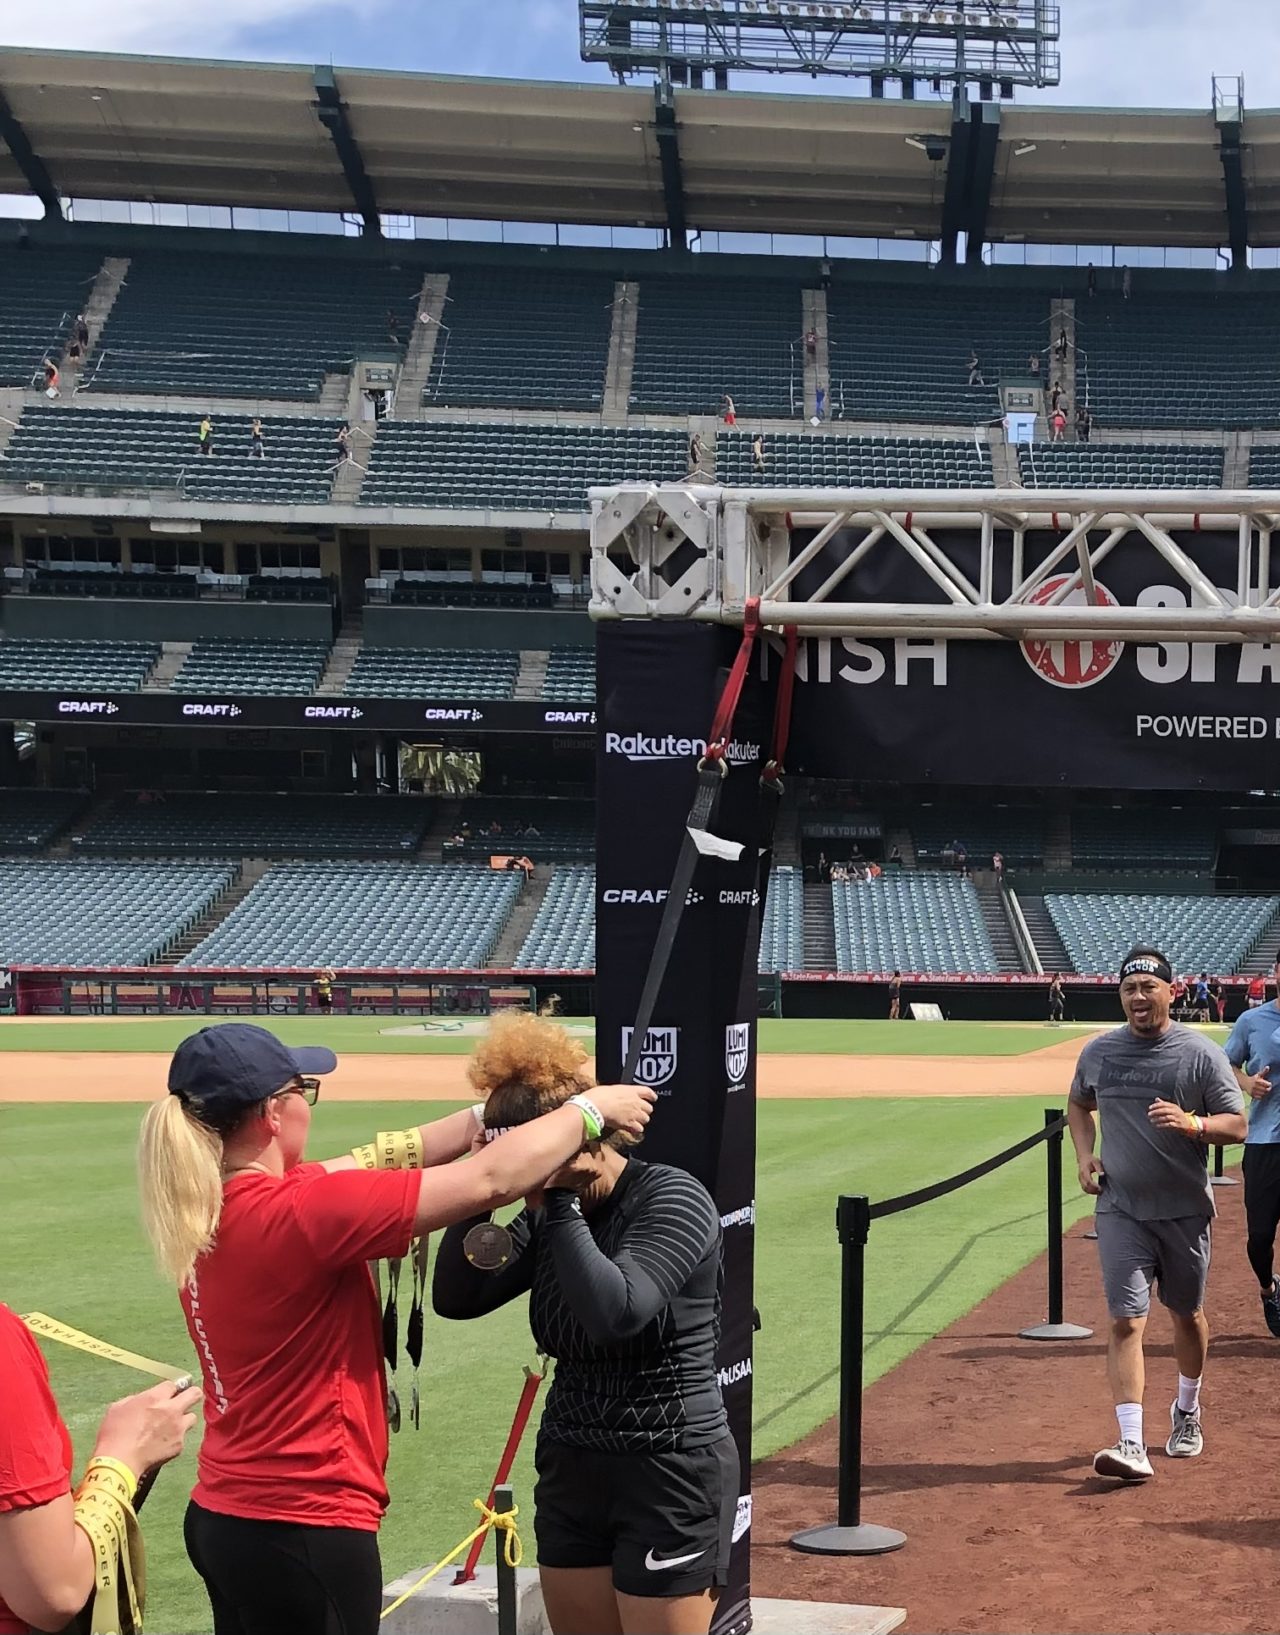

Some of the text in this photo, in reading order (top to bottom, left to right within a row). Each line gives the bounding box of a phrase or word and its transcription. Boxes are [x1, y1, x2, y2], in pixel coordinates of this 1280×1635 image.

[58, 701, 105, 713] CRAFT
[182, 703, 229, 715] CRAFT
[305, 706, 351, 718] CRAFT
[425, 708, 471, 720] CRAFT
[544, 711, 589, 723] CRAFT
[1136, 715, 1267, 740] POWERED
[605, 732, 707, 756] Rakuten
[603, 889, 671, 904] CRAF
[719, 890, 752, 904] CRAFT
[728, 1028, 747, 1050] LUMI
[1107, 1069, 1151, 1083] Hurley
[20, 1314, 76, 1339] HARDE
[728, 1357, 752, 1384] USAA
